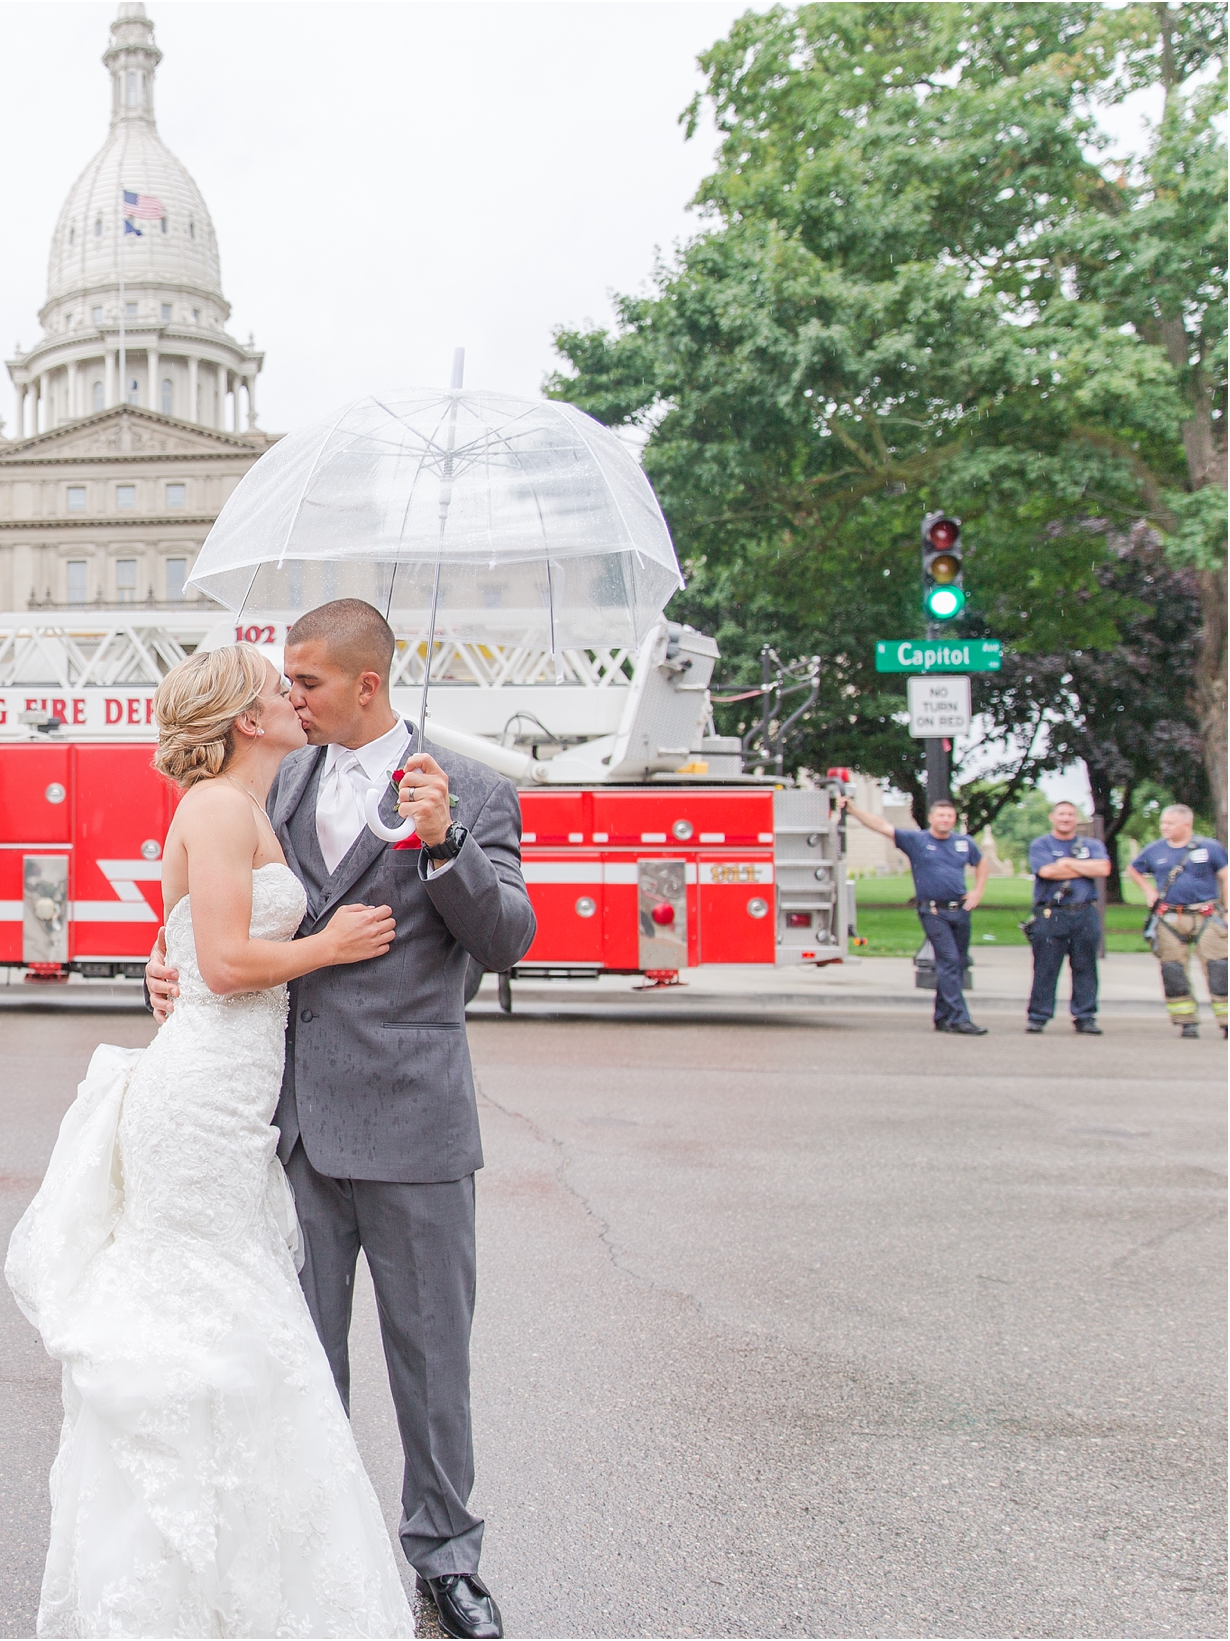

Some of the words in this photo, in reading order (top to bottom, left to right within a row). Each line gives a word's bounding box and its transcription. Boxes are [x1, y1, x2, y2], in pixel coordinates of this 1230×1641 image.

[235, 626, 275, 643] 102
[897, 642, 970, 669] Capitol
[930, 686, 948, 698] NO
[922, 701, 958, 713] TURN
[915, 716, 934, 728] ON
[939, 716, 965, 728] RED
[710, 864, 759, 883] 911
